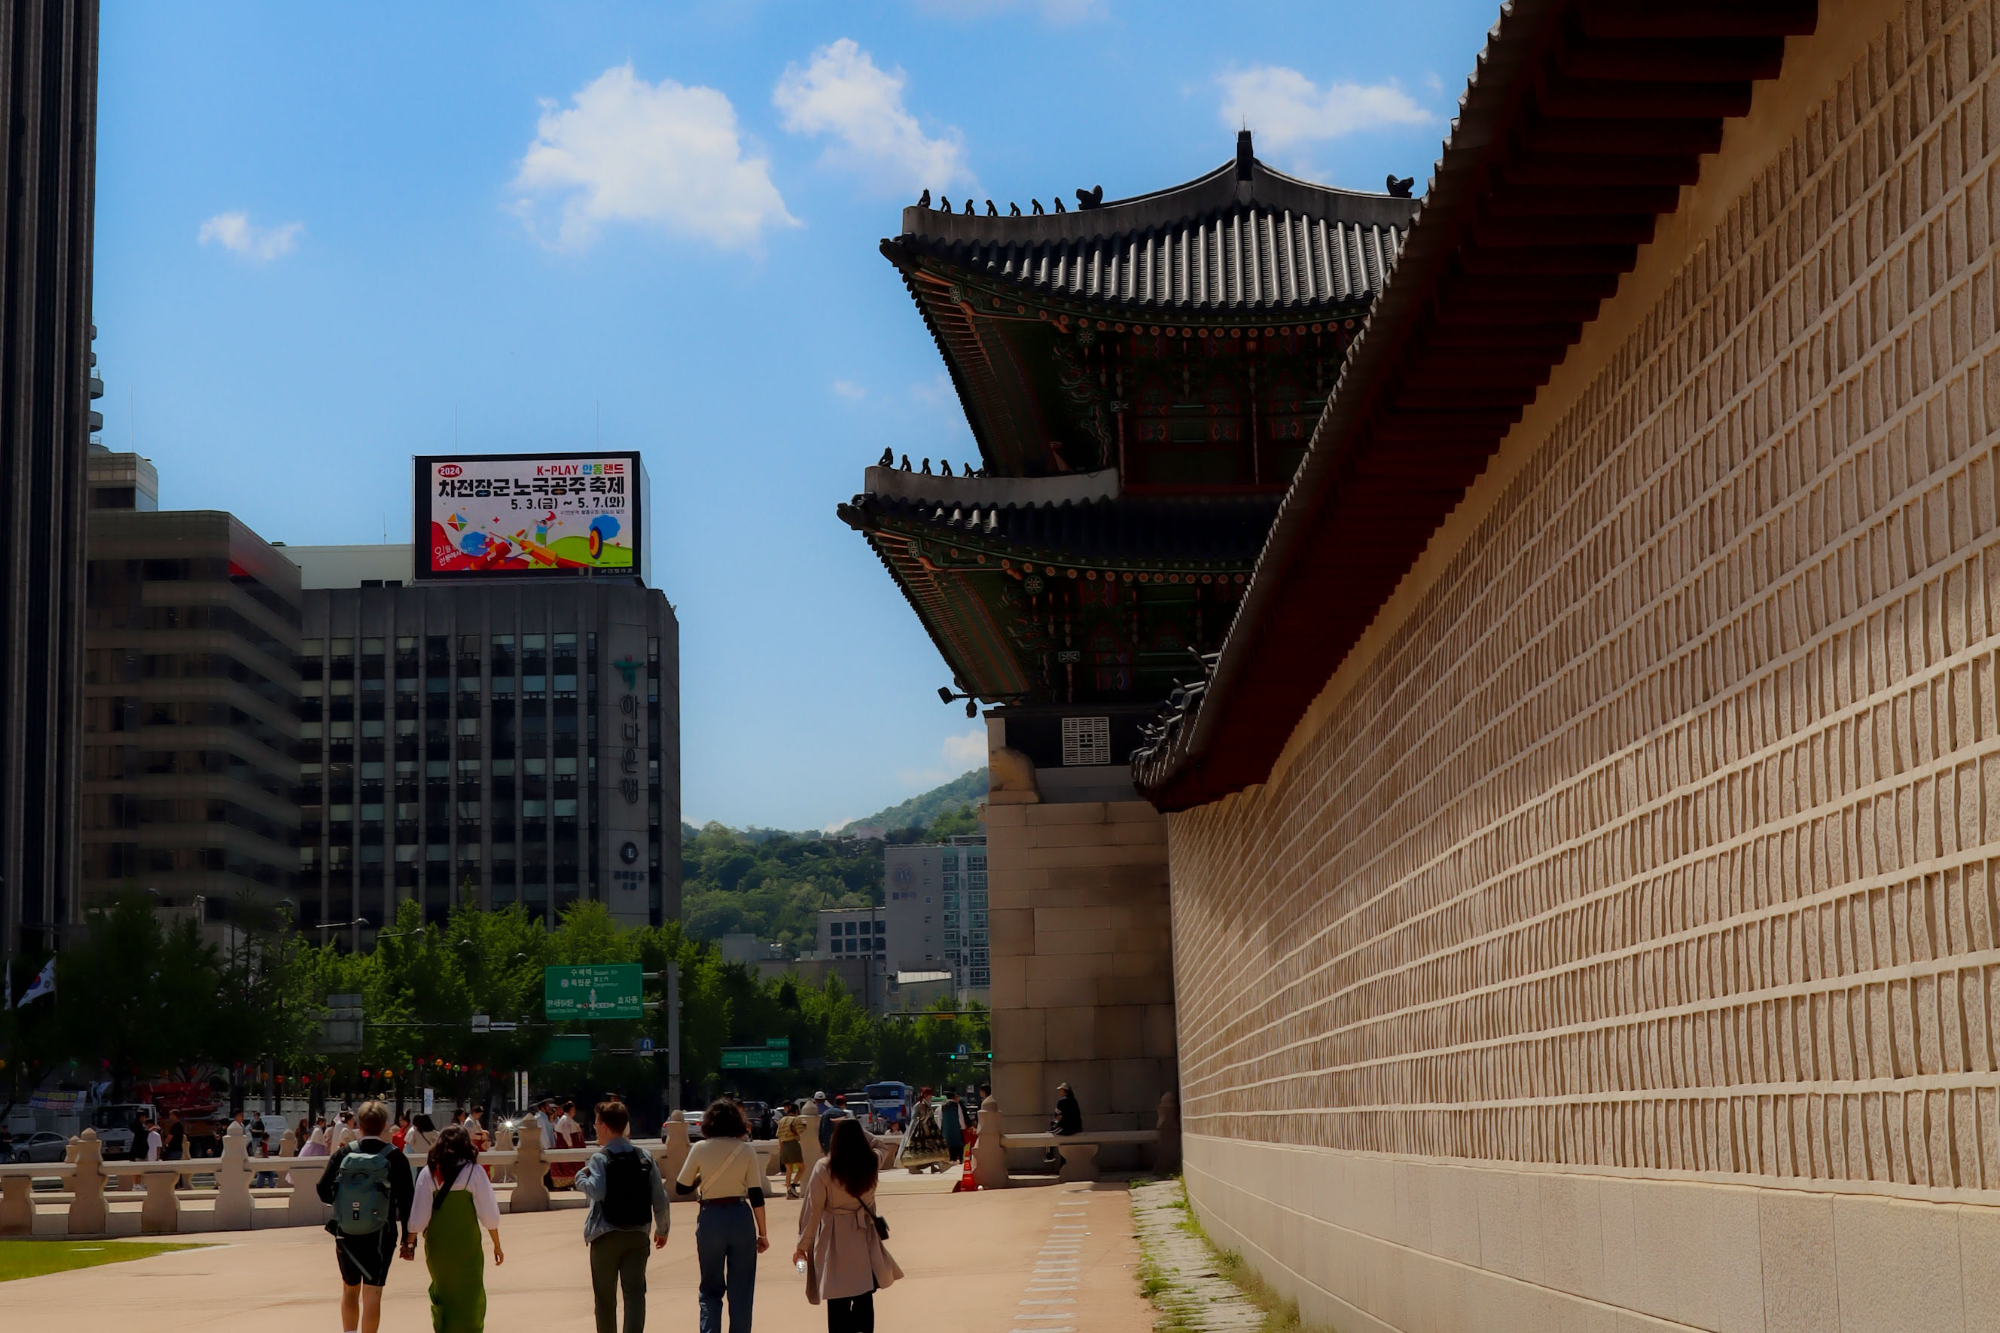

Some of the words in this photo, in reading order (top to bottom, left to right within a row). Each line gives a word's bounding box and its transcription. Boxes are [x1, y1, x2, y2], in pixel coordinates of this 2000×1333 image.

[440, 466, 460, 476] 2024
[537, 465, 579, 476] K-PLAY
[582, 464, 624, 475] 안동랜드
[438, 478, 510, 498] 차전장군
[513, 476, 586, 496] 노국공주
[589, 476, 625, 495] 축제
[619, 693, 641, 805] 하나은행
